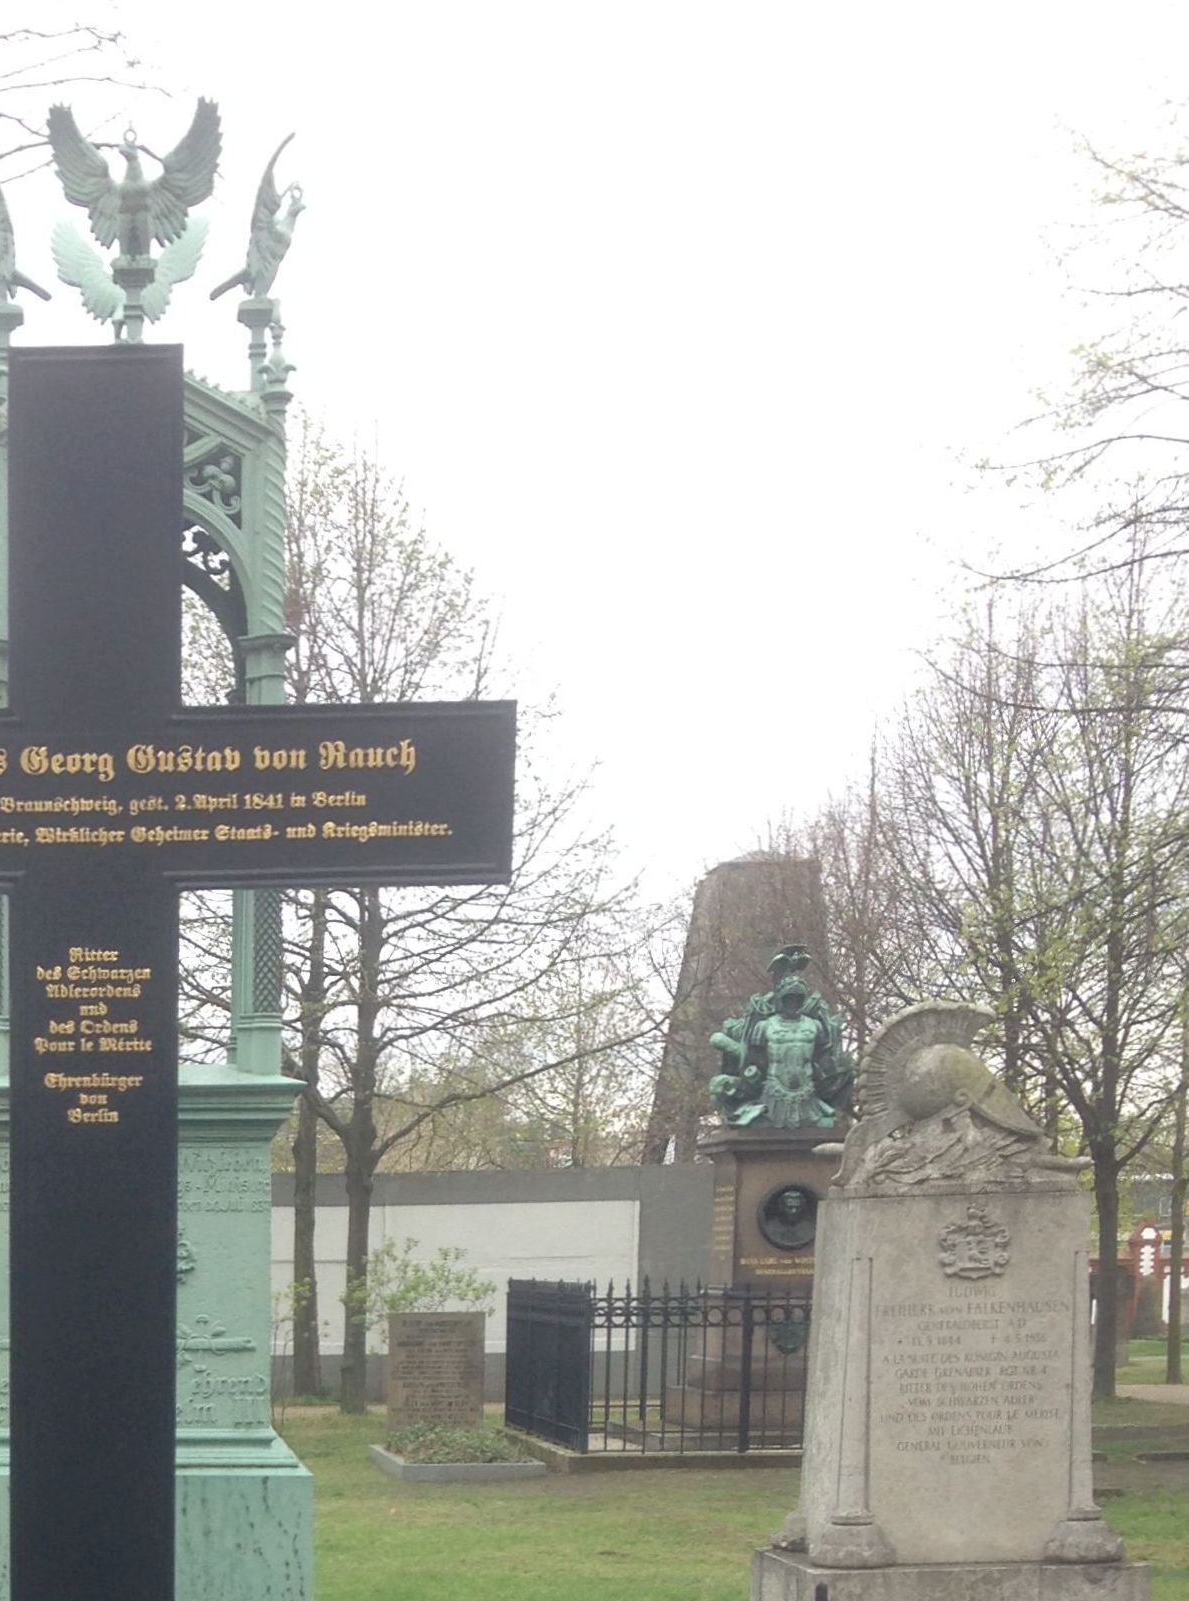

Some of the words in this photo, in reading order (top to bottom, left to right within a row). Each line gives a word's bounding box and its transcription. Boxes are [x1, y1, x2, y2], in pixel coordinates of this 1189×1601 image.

[19, 745, 116, 782] Georg
[125, 744, 243, 775] Gustav
[252, 745, 308, 772] von
[317, 739, 418, 773] Rauch
[128, 795, 169, 816] gest.
[192, 793, 239, 812] April
[243, 793, 284, 810] 1841
[289, 793, 307, 810] in
[312, 791, 368, 808] Berlin
[35, 826, 124, 845] Wirklicher
[130, 825, 210, 846] Geheimer
[214, 823, 280, 843] Staats-
[285, 823, 317, 841] und
[321, 820, 454, 843] Kriegsminister.
[68, 947, 119, 963] Ritter
[36, 966, 63, 981] des
[67, 965, 151, 984] Schwarzen
[45, 983, 142, 999] Adlerordens
[79, 1002, 108, 1016] und
[49, 1020, 75, 1035] des
[80, 1020, 139, 1036] Ordens
[34, 1037, 76, 1055] Pour
[81, 1037, 95, 1052] le
[44, 1072, 144, 1091] Ehrenbürger
[79, 1093, 109, 1107] von
[67, 1108, 120, 1124] Berlin
[967, 1300, 1070, 1316] FALKENHAUSEN
